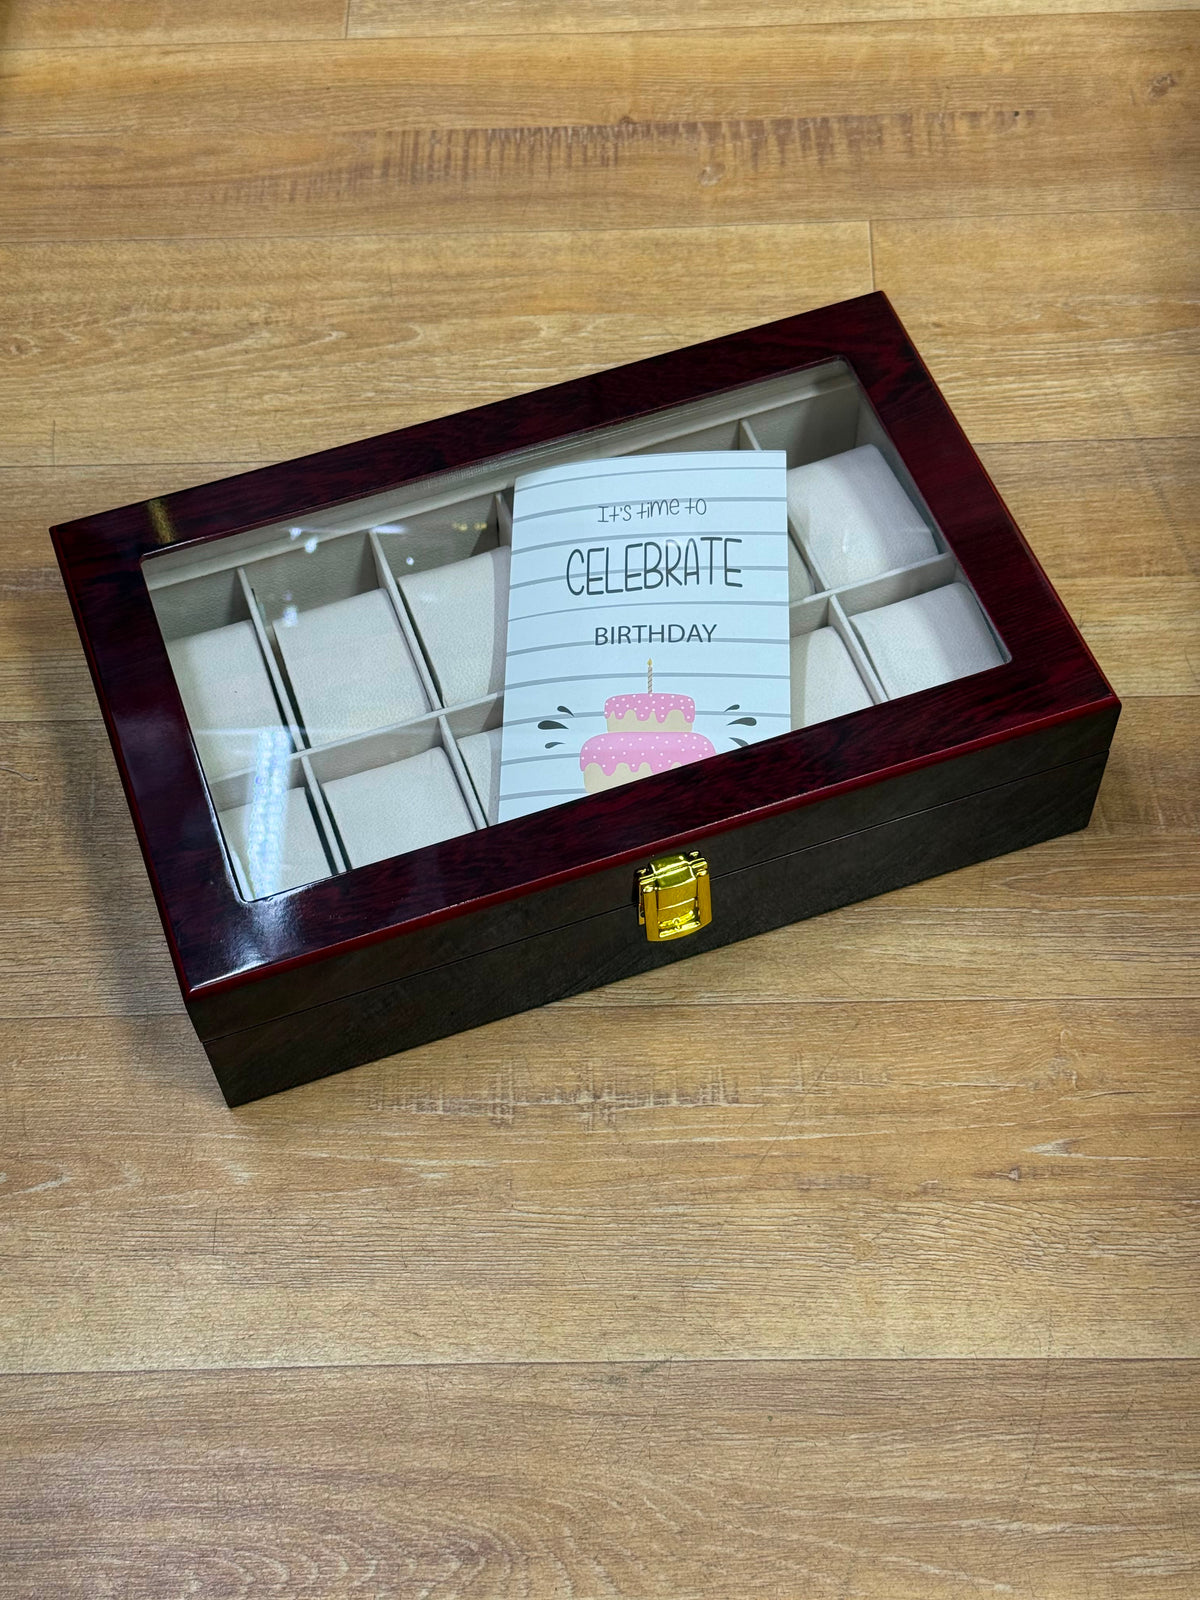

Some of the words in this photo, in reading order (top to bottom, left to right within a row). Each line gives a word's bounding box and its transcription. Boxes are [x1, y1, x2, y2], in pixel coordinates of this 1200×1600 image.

[597, 504, 632, 523] It's
[637, 498, 680, 519] time
[685, 498, 707, 516] to
[566, 536, 743, 596] CELEBRATE
[595, 624, 718, 646] BIRTHDAY
